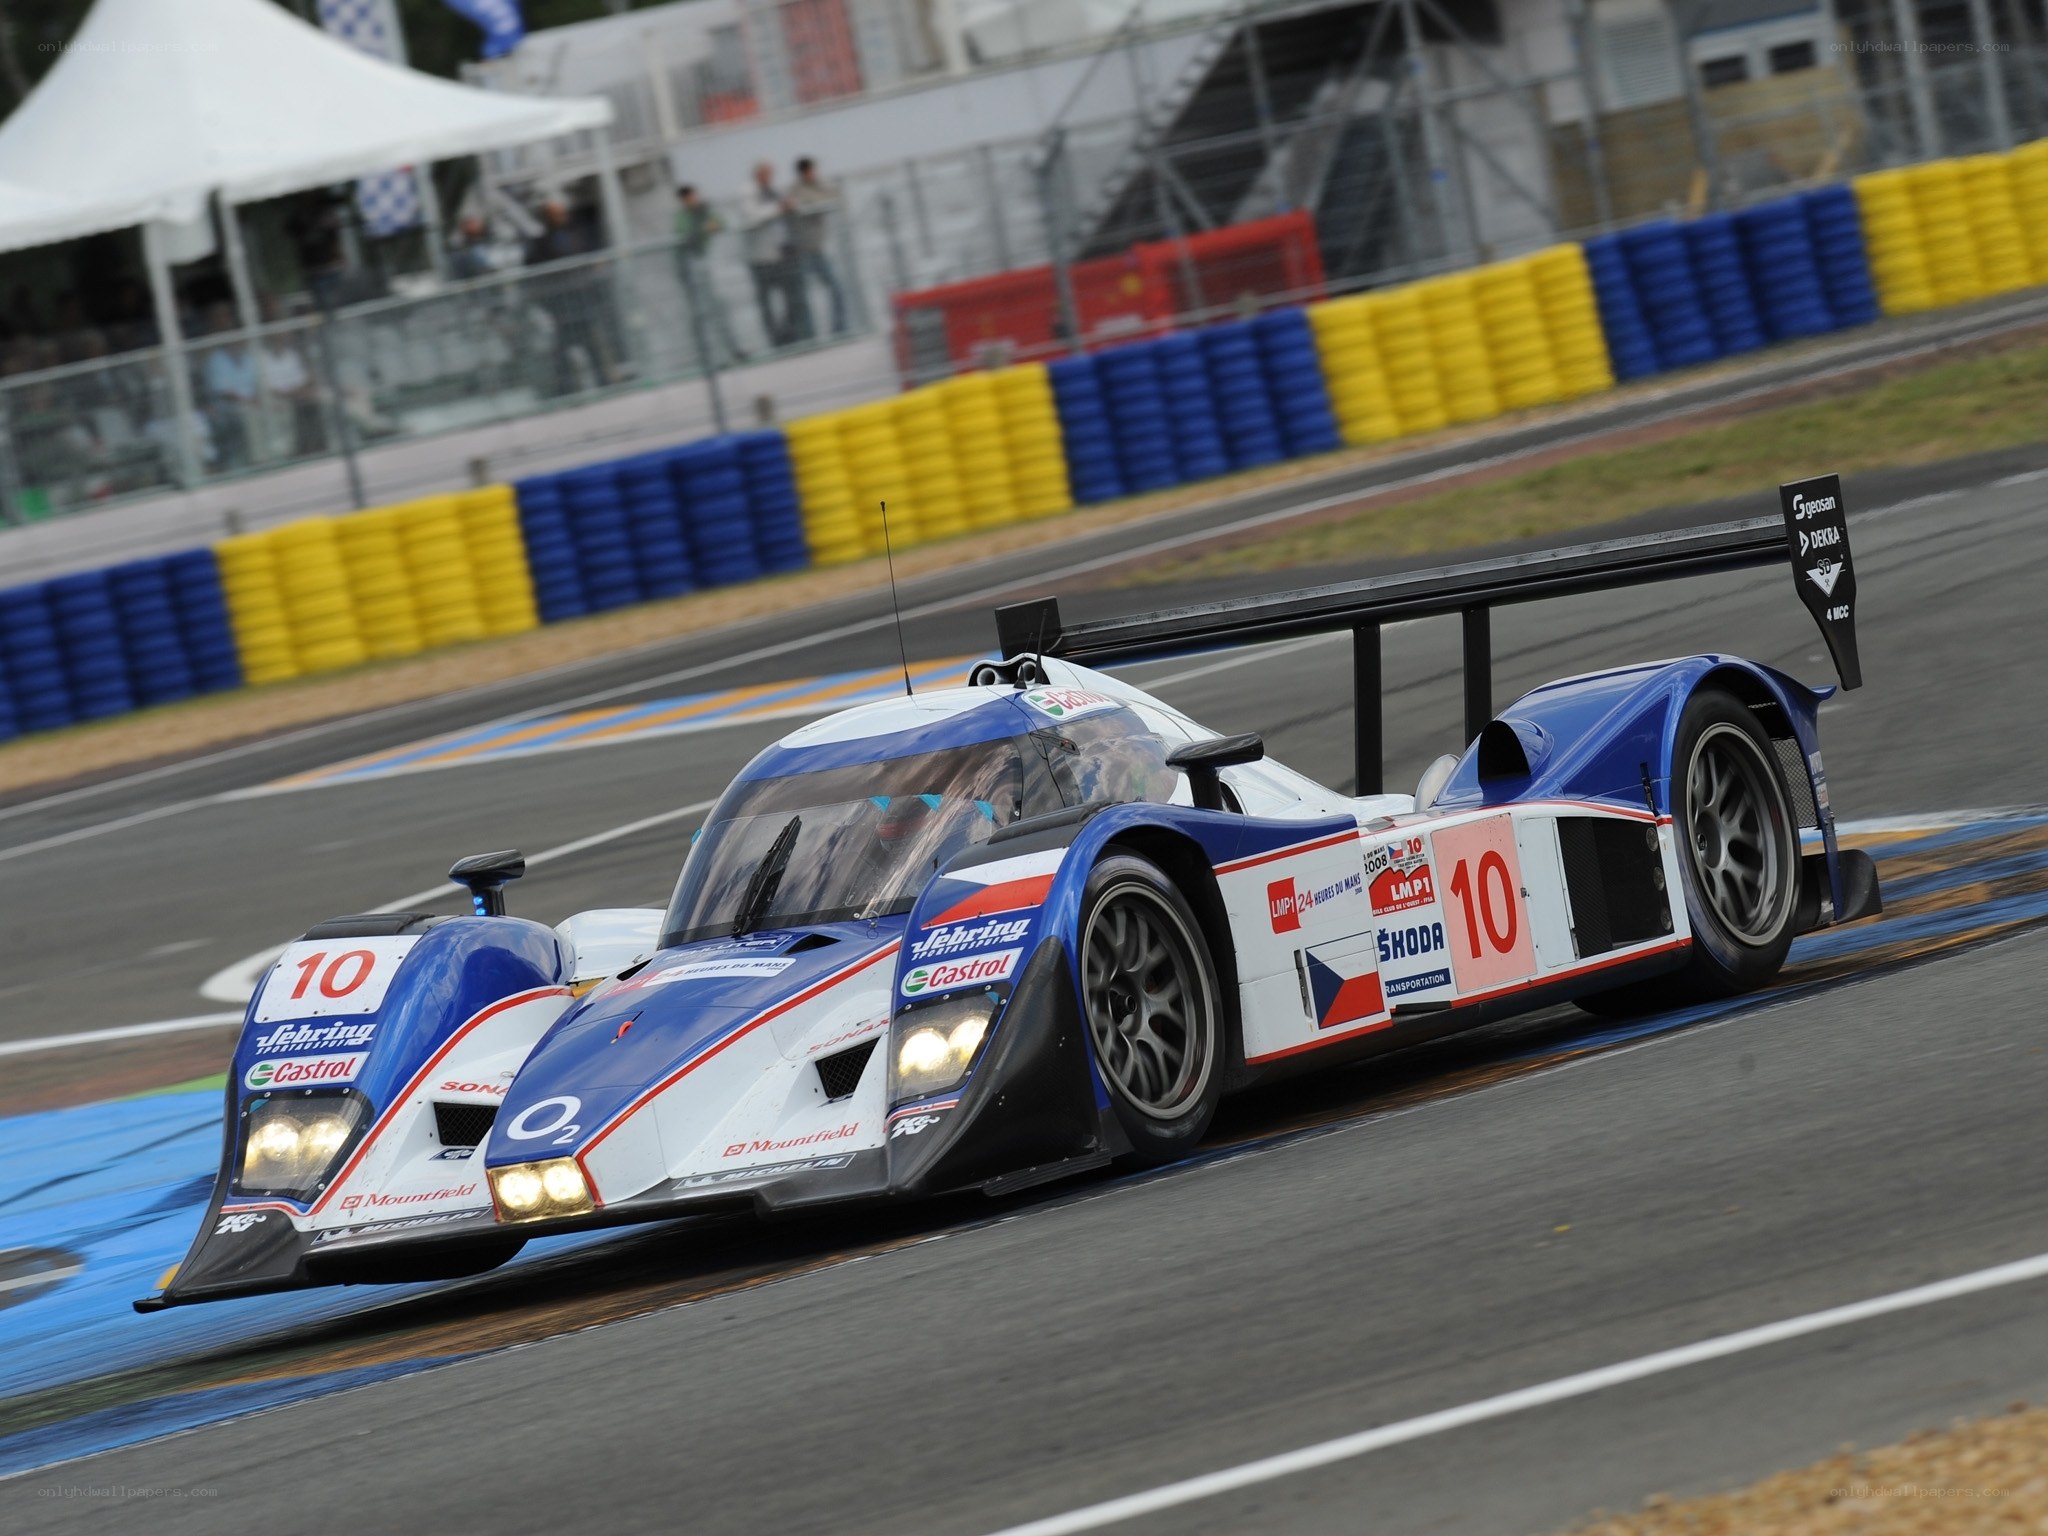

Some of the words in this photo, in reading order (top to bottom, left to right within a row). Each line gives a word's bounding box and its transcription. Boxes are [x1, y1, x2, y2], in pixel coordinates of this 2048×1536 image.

[1806, 495, 1836, 519] geosan
[1811, 525, 1841, 549] DEKRA
[1407, 837, 1422, 855] 10
[1271, 896, 1296, 918] LMP1
[1297, 889, 1314, 914] 24
[1313, 885, 1335, 906] HEURES
[1335, 880, 1344, 896] DU
[1344, 872, 1361, 891] MANS
[1390, 877, 1431, 901] LMP1
[1450, 850, 1518, 959] 10
[911, 919, 1032, 954] Sebring
[1377, 922, 1445, 963] ŠKODA
[290, 949, 376, 1000] 10
[684, 964, 728, 976] HEURES
[731, 962, 750, 970] DU
[751, 961, 788, 969] MANS
[929, 953, 1011, 987] Castrol
[255, 1020, 378, 1048] Sebring
[273, 1057, 357, 1083] Castrol
[747, 1121, 860, 1154] Mountfield
[721, 1156, 848, 1181] MICHELIN
[363, 1183, 479, 1208] Mountfield
[358, 1209, 482, 1234] MICHELIN
